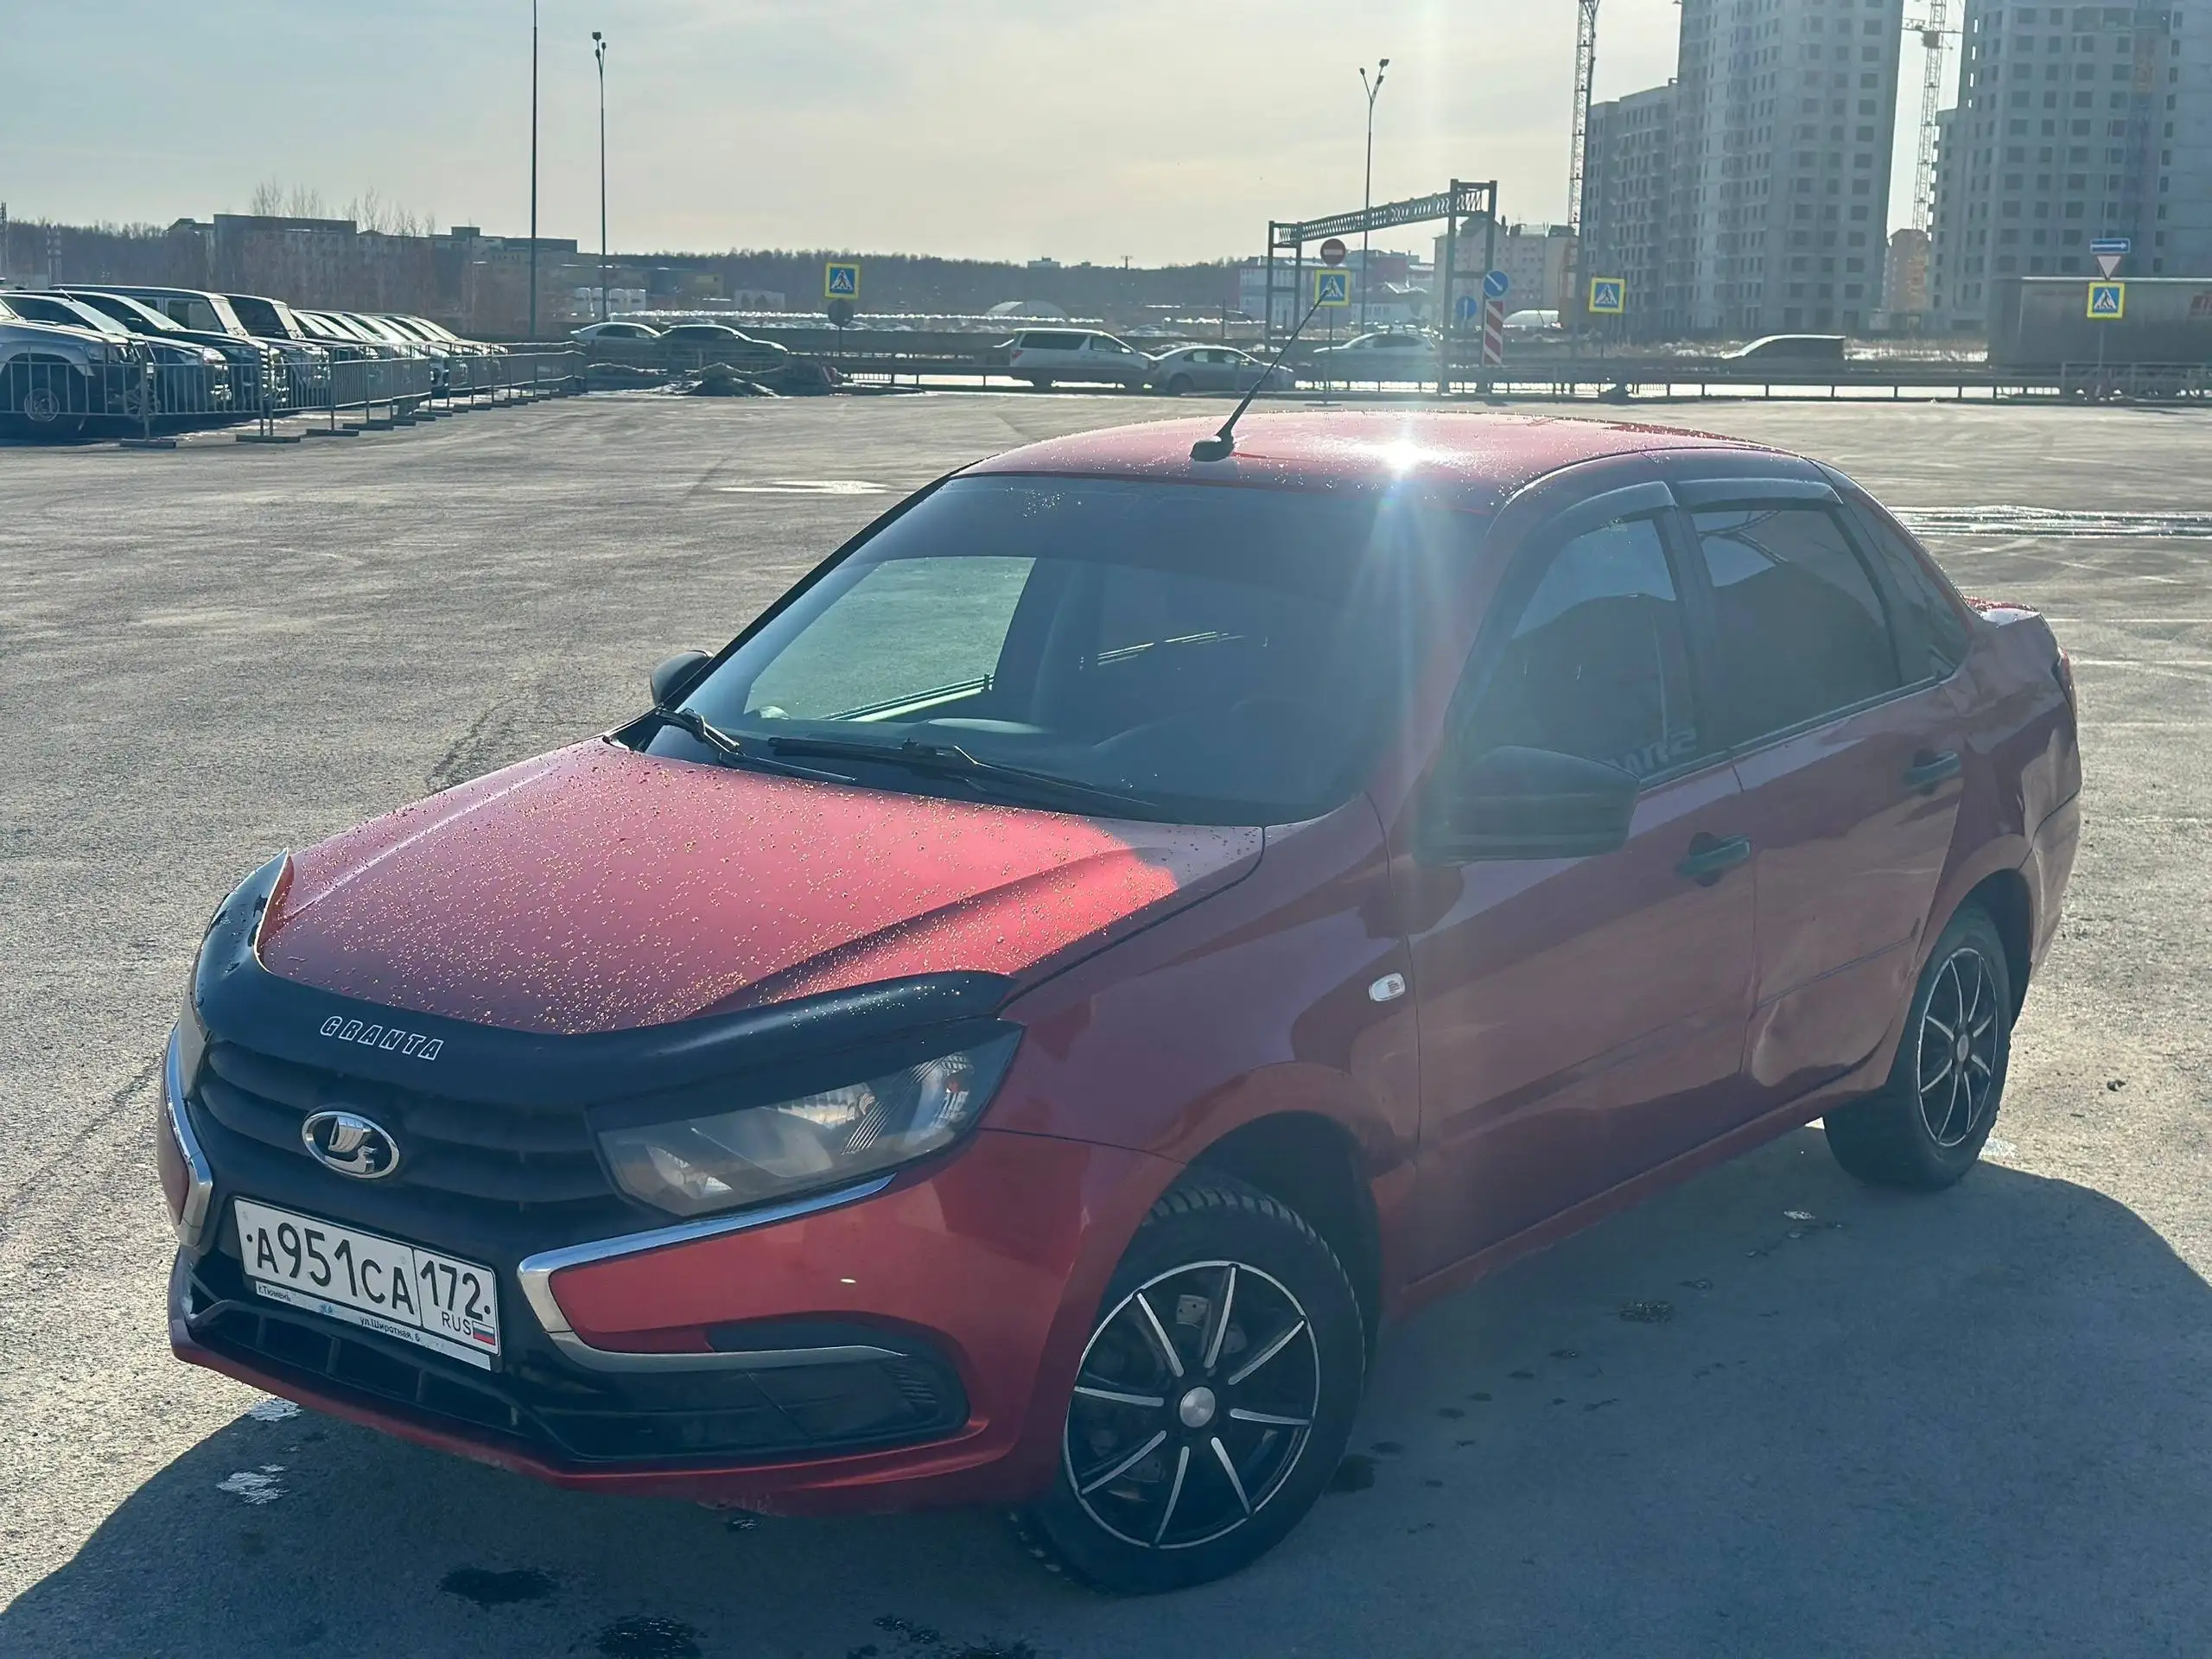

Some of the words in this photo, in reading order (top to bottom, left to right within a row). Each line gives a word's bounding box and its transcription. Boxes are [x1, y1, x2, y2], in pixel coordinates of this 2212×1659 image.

[320, 1015, 444, 1061] GRANTA
[257, 1222, 415, 1315] А951СА
[421, 1260, 483, 1322] 172
[442, 1311, 472, 1336] RUS
